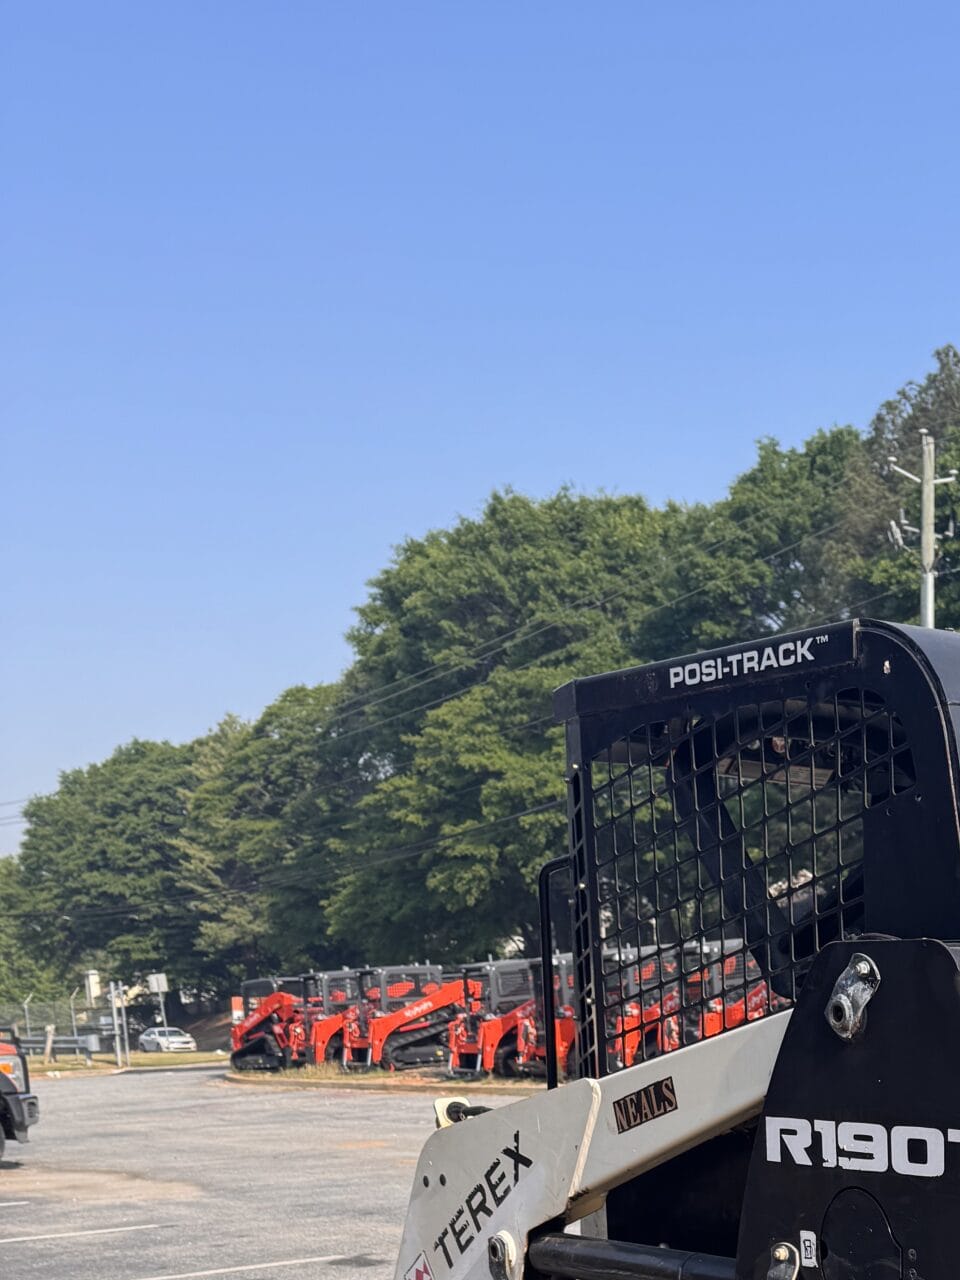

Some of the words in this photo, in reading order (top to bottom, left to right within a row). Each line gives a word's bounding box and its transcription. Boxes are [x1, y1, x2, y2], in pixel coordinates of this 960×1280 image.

[669, 637, 815, 689] POSI-TRACK
[614, 1078, 678, 1132] NEALS
[433, 1130, 533, 1269] TEREX
